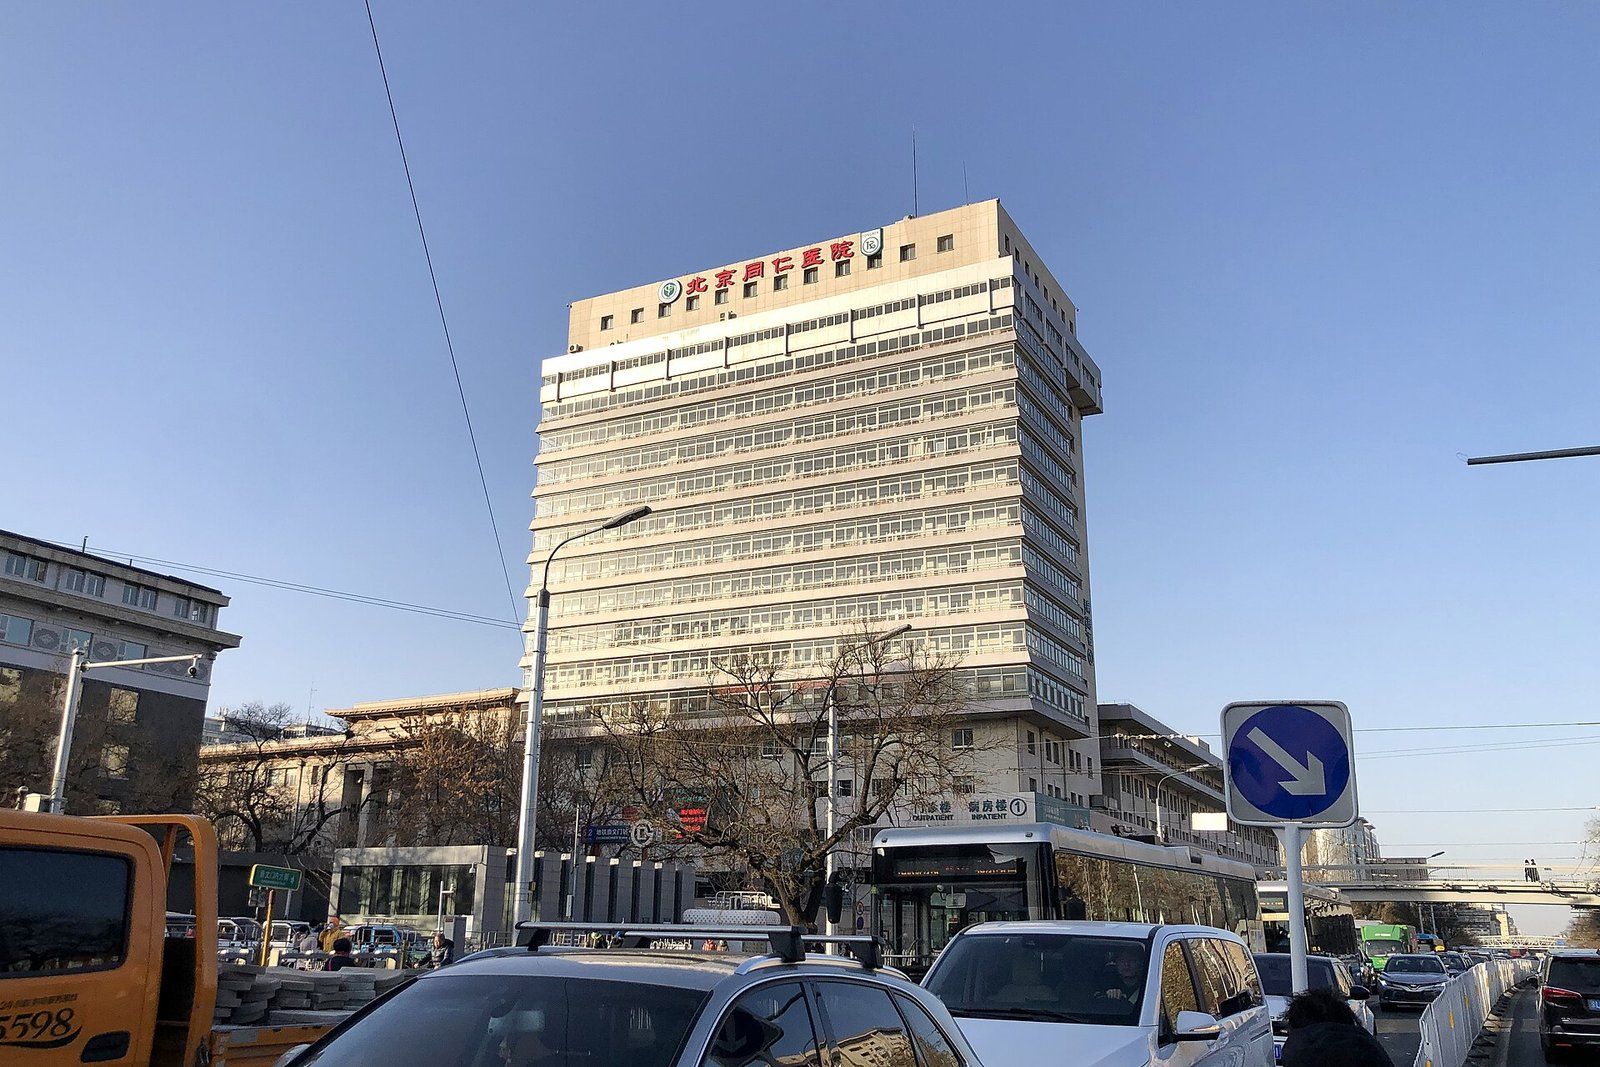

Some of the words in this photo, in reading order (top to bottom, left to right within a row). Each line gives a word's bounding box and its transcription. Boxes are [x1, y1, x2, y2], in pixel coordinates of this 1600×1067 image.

[686, 240, 854, 295] 北京同仁医院
[969, 799, 1007, 812] 病房楼
